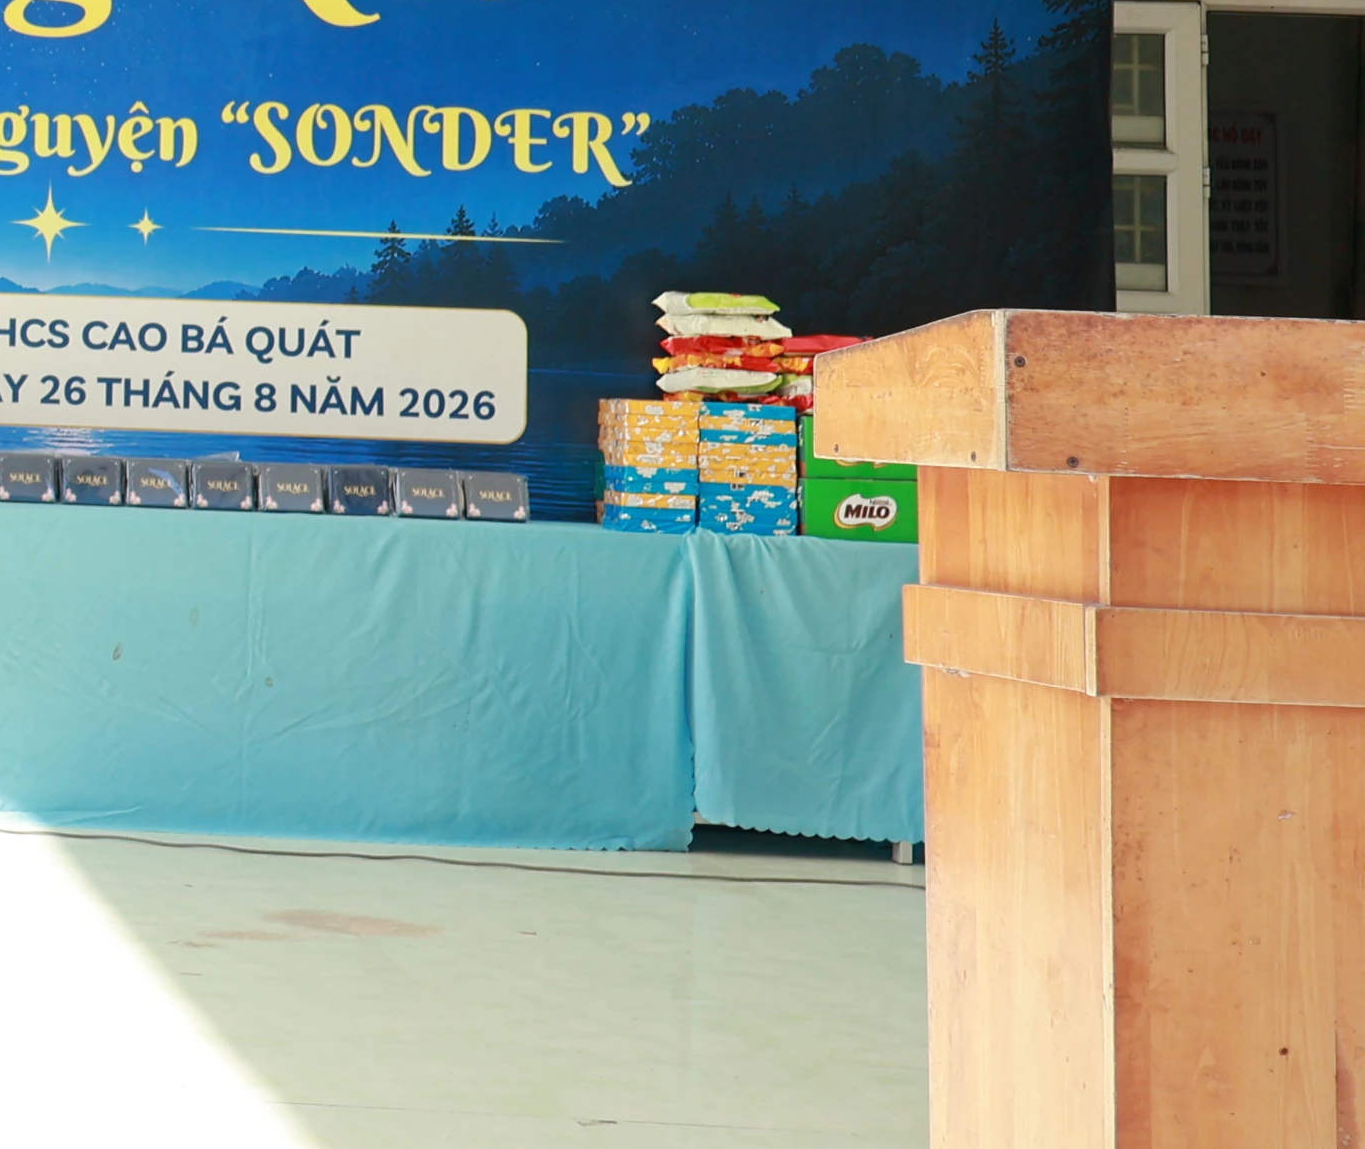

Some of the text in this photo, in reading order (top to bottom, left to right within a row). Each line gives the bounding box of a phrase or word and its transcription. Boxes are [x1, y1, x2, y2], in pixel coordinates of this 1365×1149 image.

[82, 320, 167, 352] CAO
[180, 314, 235, 356] BÁ
[244, 317, 362, 364] QUÁT
[40, 374, 87, 406] 26
[97, 370, 241, 412] THÁNG
[254, 382, 279, 412] 8
[289, 376, 384, 418] NĂM
[398, 387, 496, 420] 2026
[844, 504, 890, 519] MILO
